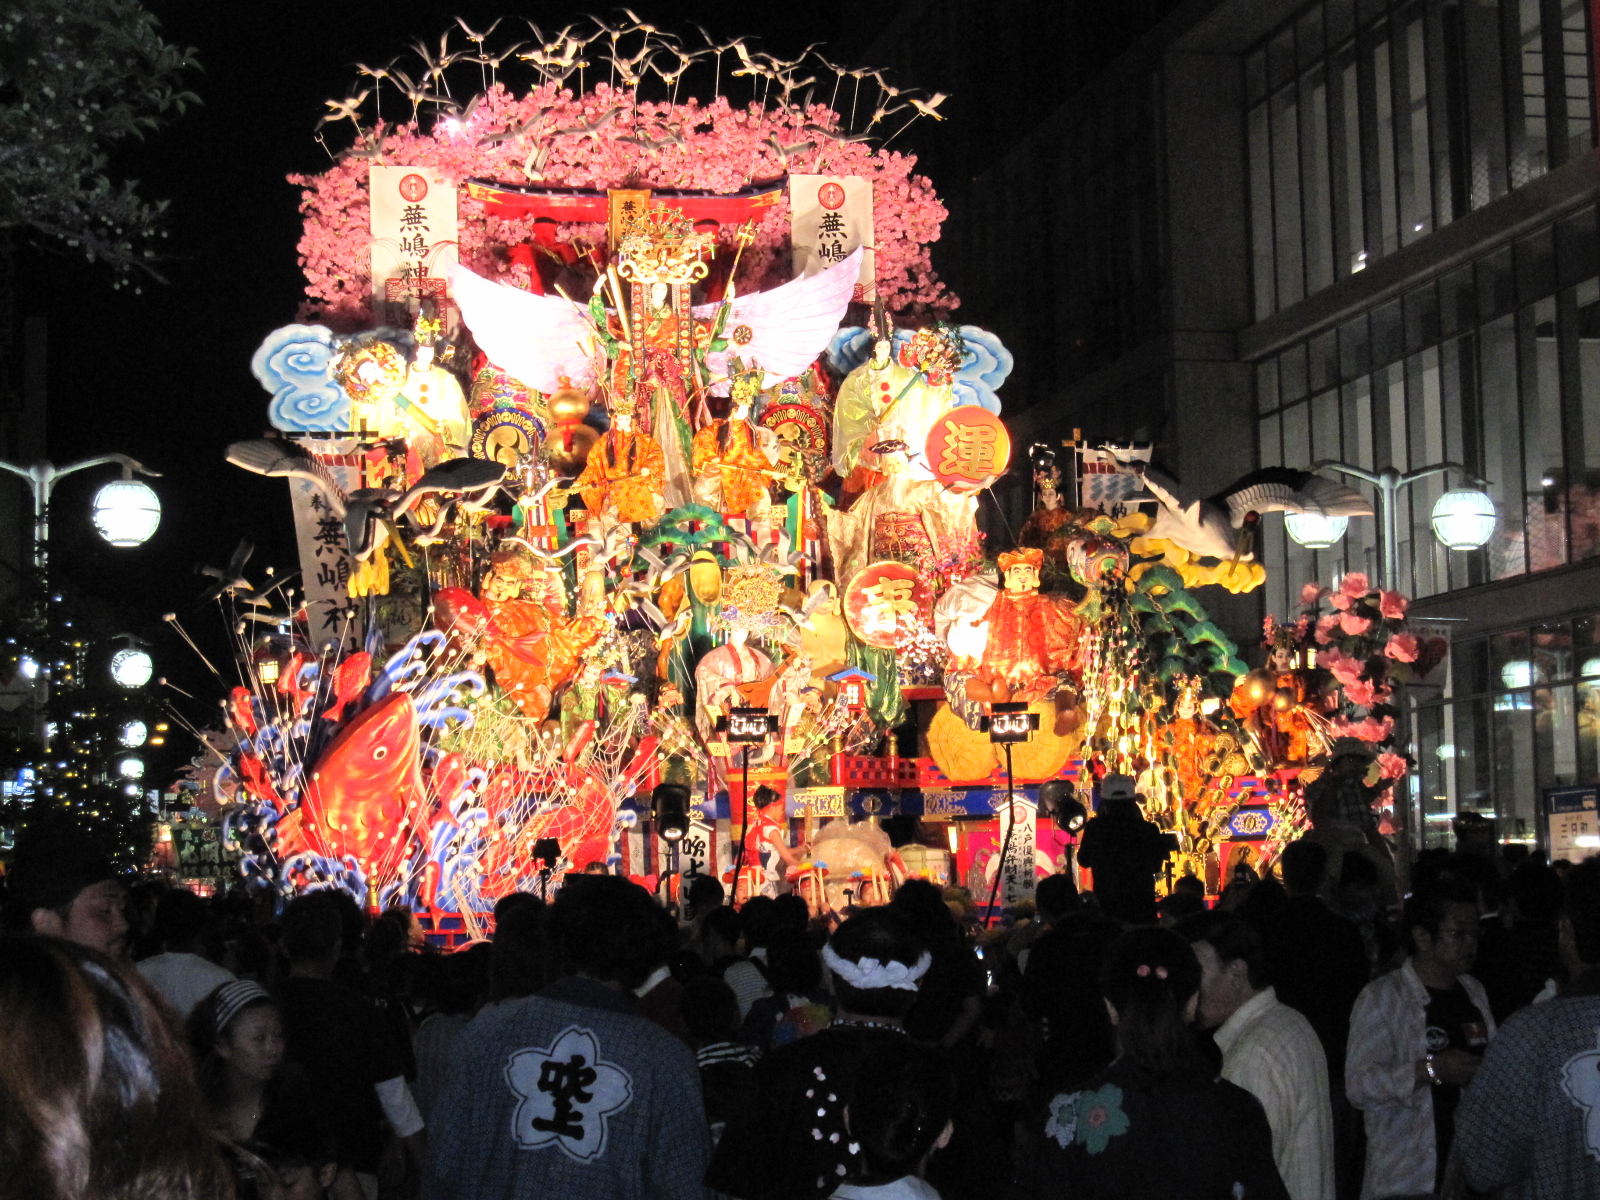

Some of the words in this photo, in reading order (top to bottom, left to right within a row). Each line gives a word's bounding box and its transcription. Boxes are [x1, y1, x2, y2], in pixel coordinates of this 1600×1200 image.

[399, 205, 430, 300] 蕪嶋神
[818, 212, 848, 270] 蕪嶋
[938, 420, 998, 480] 運
[313, 516, 362, 650] 蕪嶋神
[537, 1054, 597, 1140] 吹上
